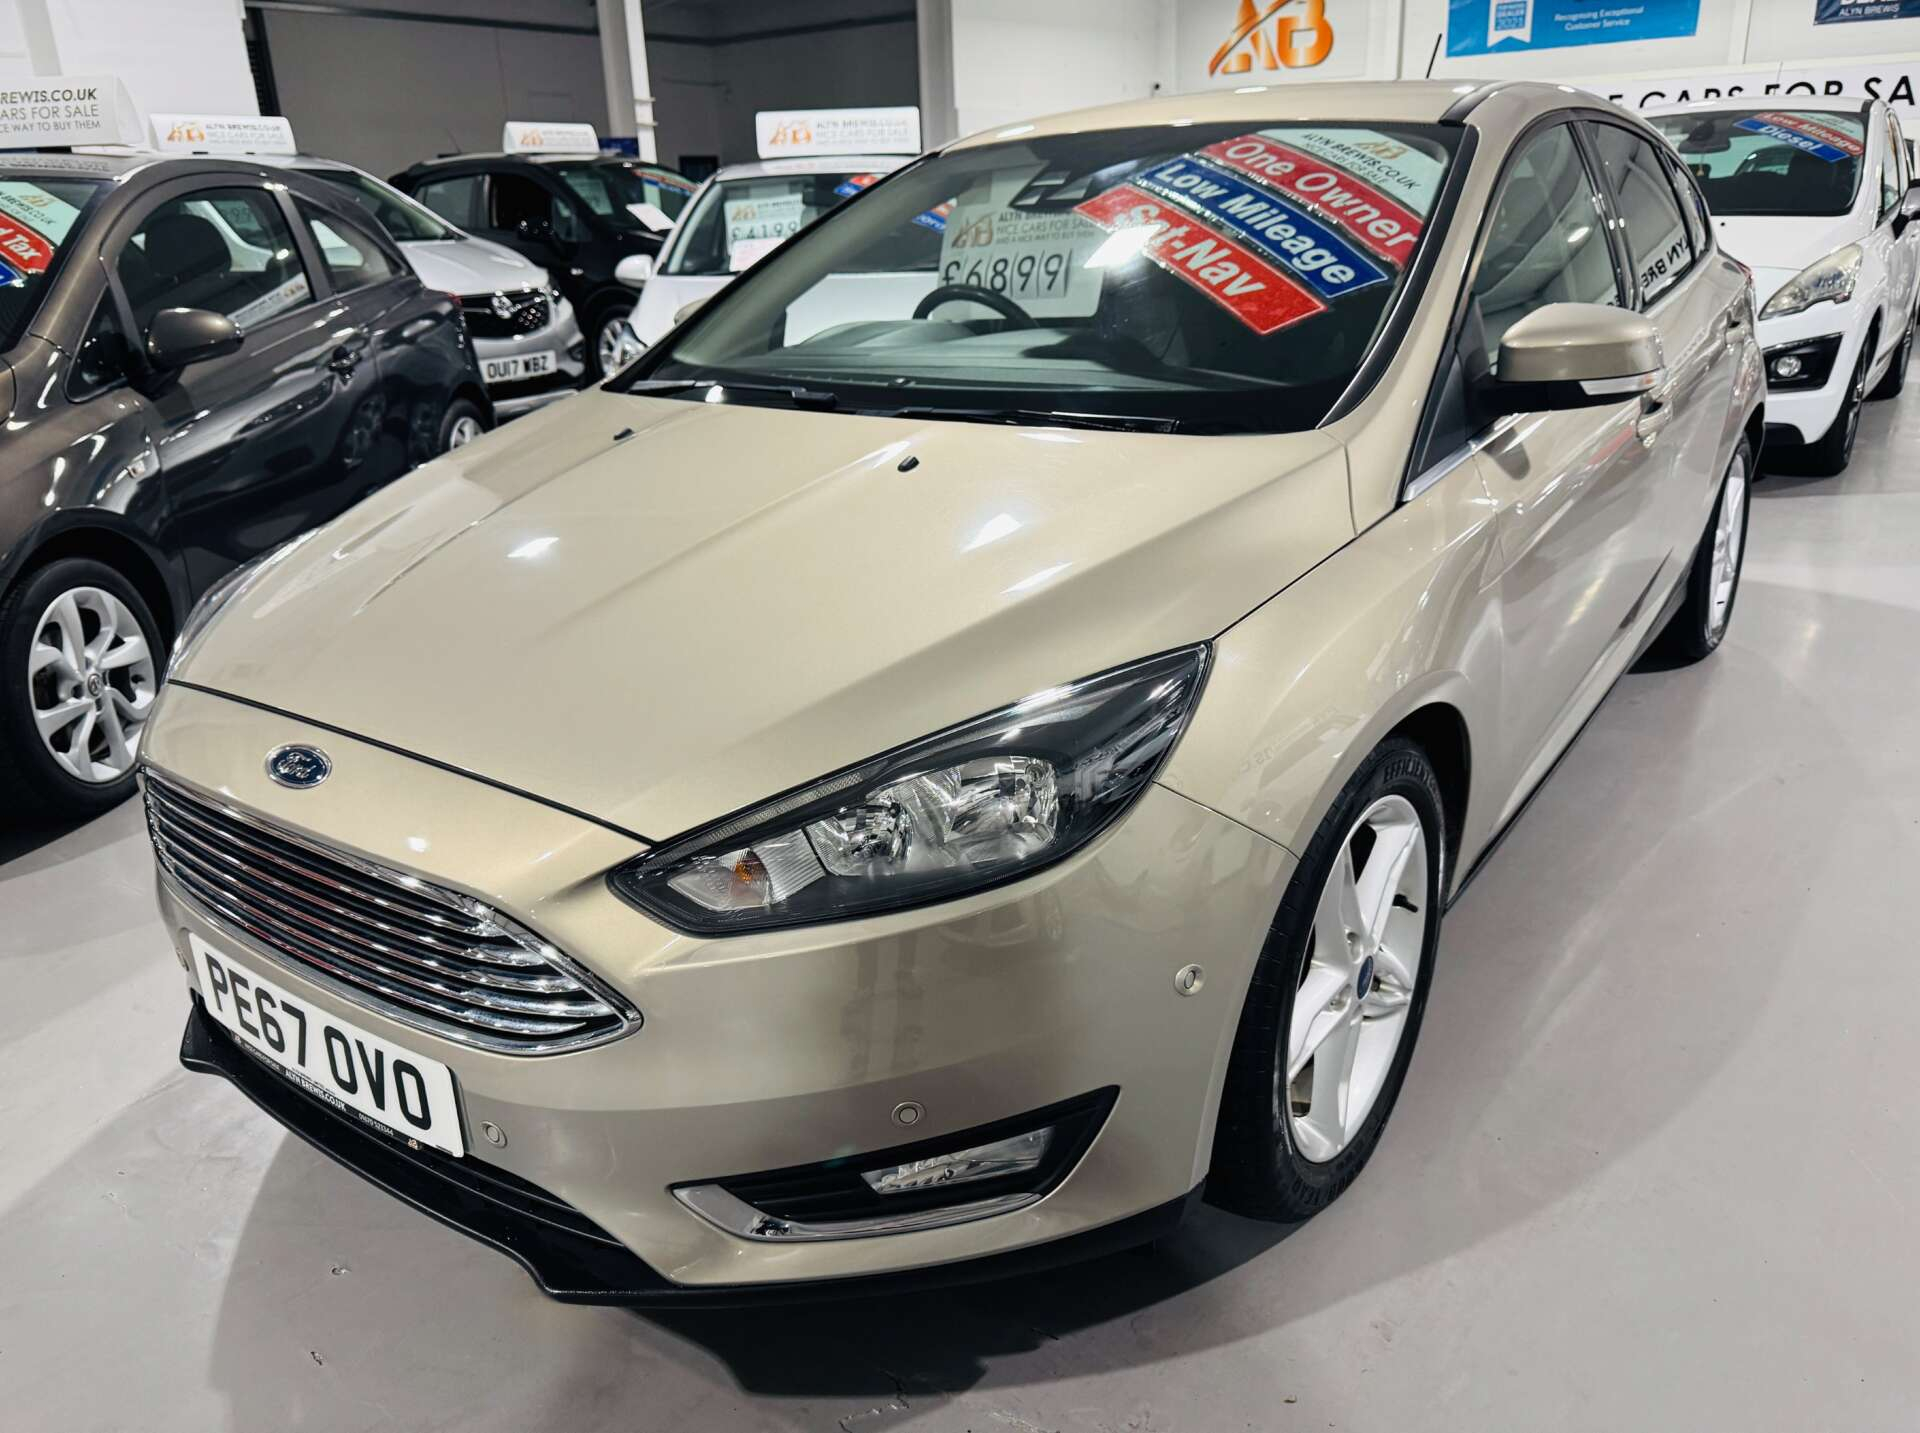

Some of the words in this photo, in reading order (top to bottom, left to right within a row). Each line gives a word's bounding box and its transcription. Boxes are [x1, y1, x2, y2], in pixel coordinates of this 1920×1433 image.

[12, 123, 34, 132] WAY
[38, 121, 50, 131] TO
[53, 121, 71, 131] BUY
[74, 119, 101, 129] THEM
[31, 105, 60, 120] FOR
[65, 104, 99, 118] SALE
[1758, 125, 1822, 151] Diesel
[1763, 113, 1799, 125] Low
[1798, 124, 1861, 152] Mileage
[1225, 142, 1295, 176] One
[1295, 172, 1417, 247] Owner
[1154, 163, 1228, 199] Low
[1218, 193, 1356, 284] Mileage
[2, 233, 42, 260] Tax
[943, 253, 1063, 292] £6899
[487, 360, 518, 379] OU17
[205, 952, 306, 1068] PE67
[324, 1025, 431, 1131] OVO
